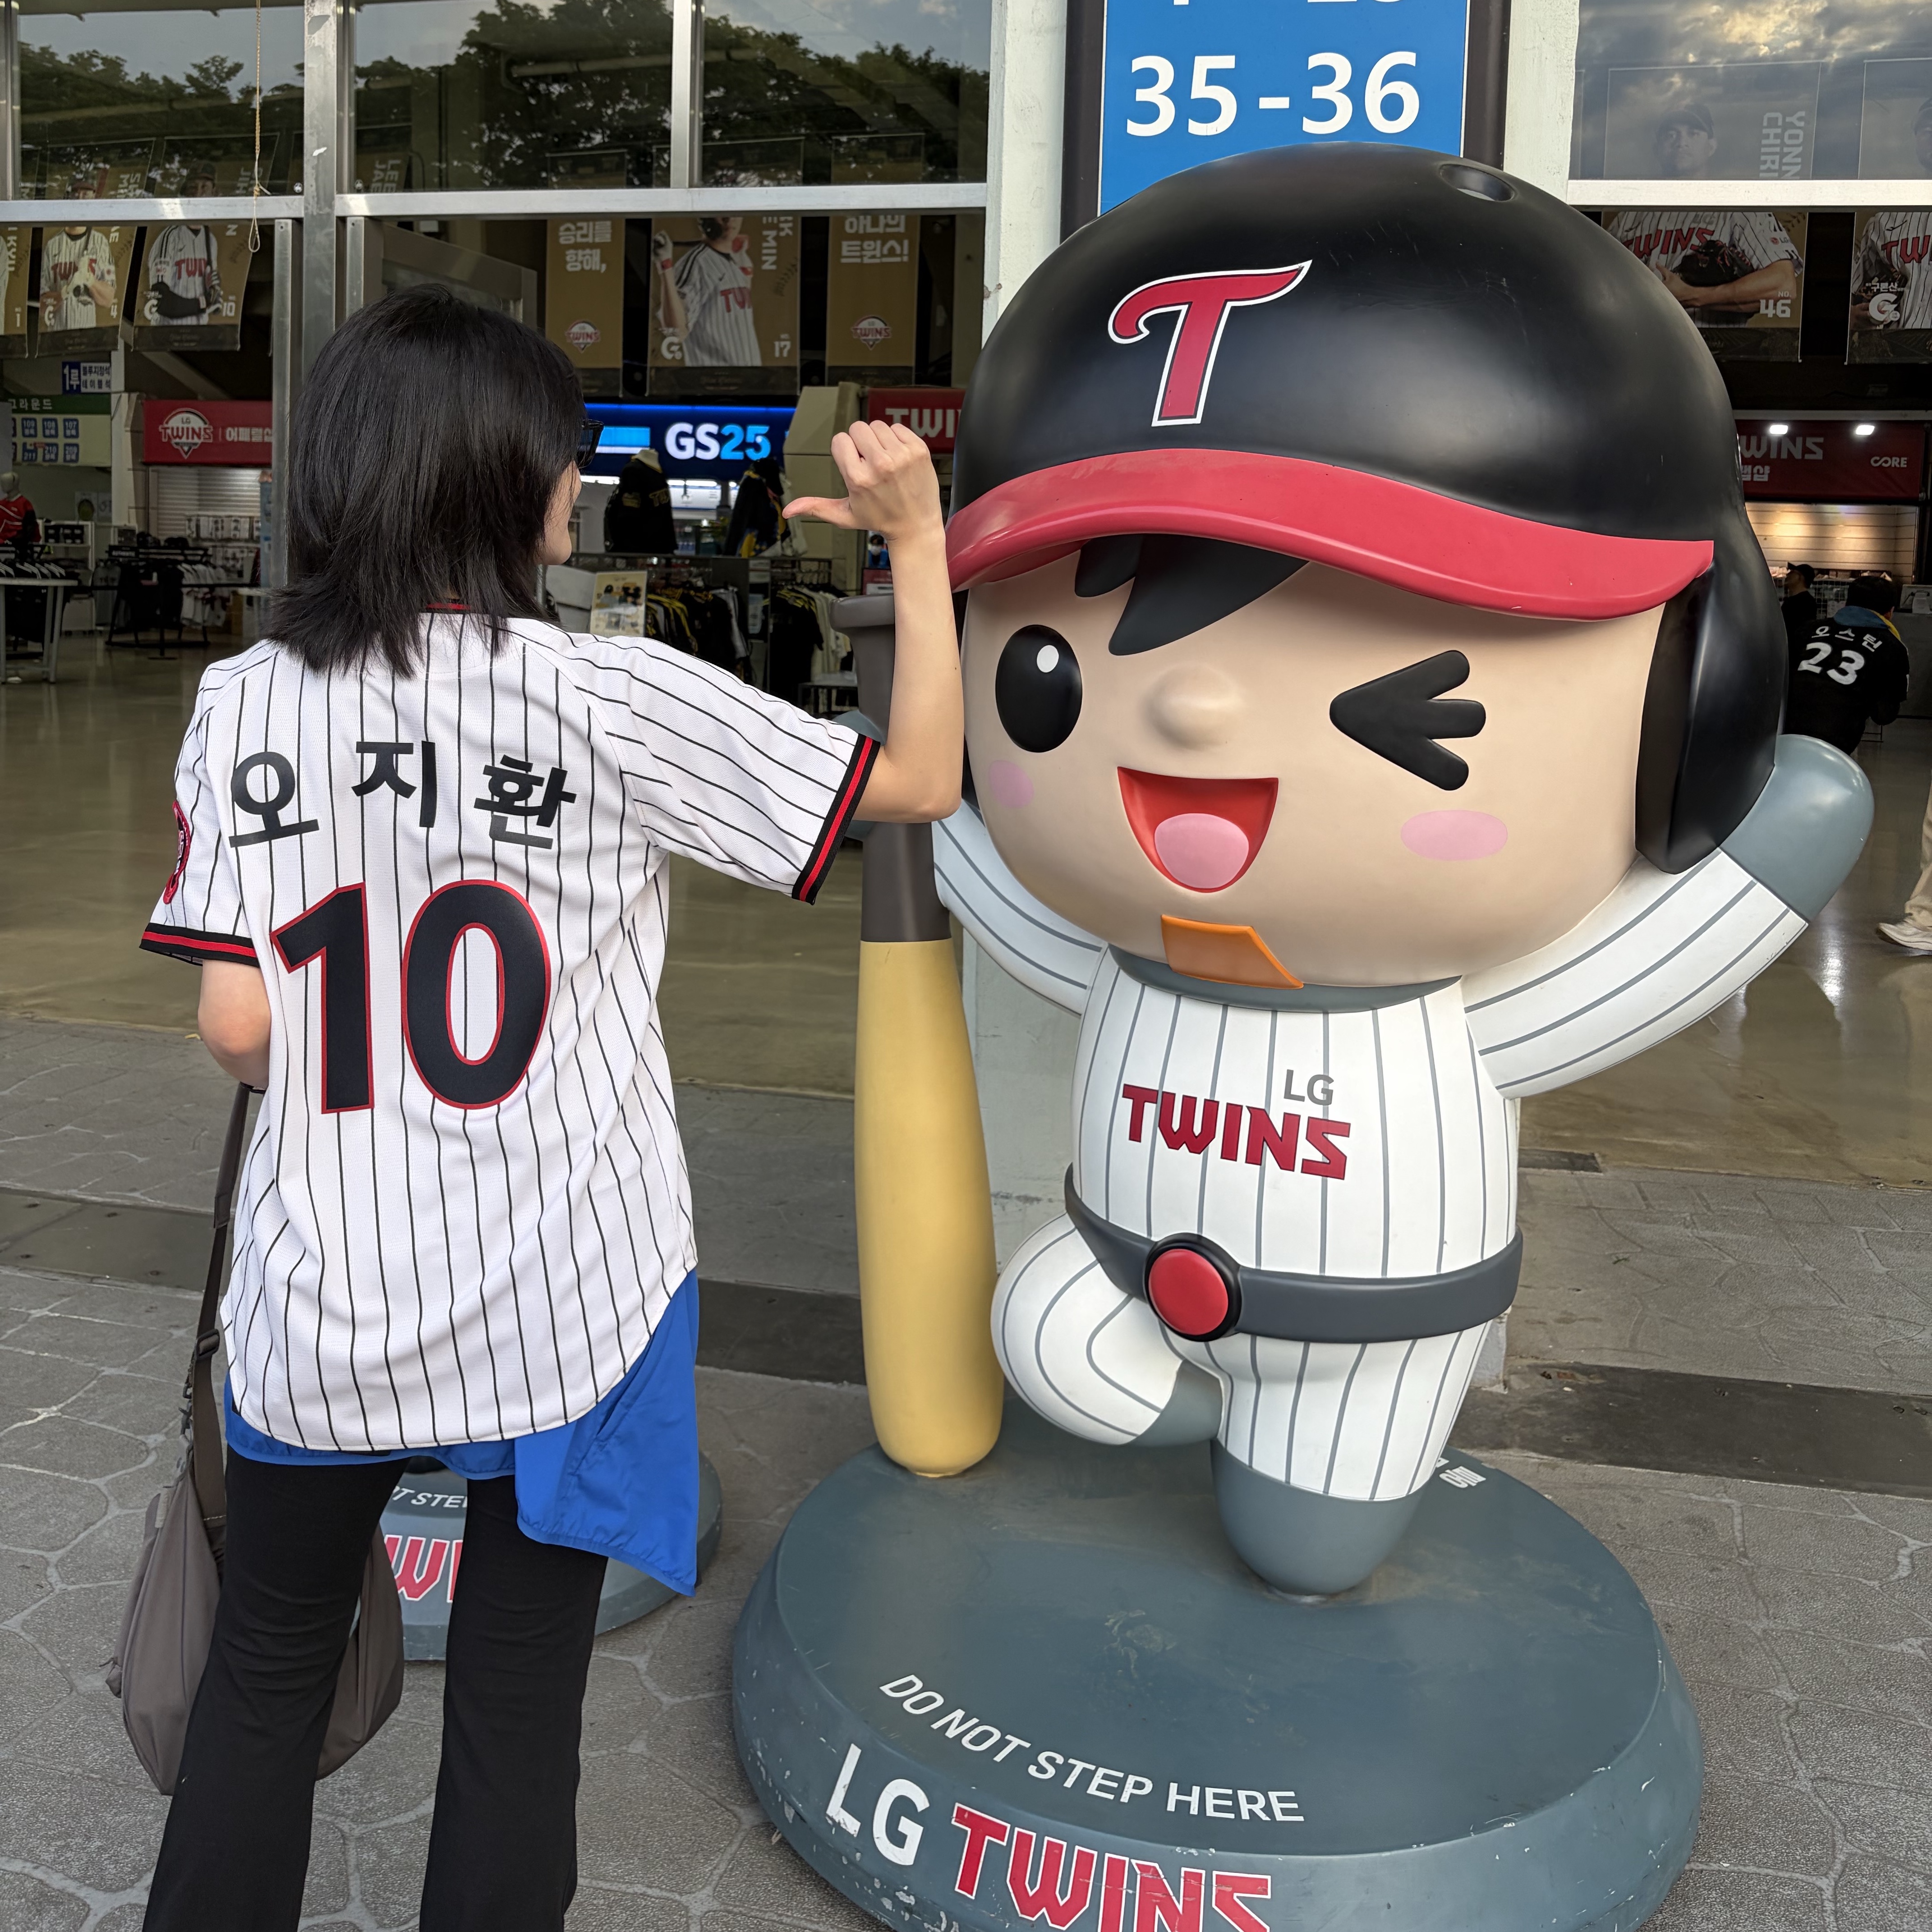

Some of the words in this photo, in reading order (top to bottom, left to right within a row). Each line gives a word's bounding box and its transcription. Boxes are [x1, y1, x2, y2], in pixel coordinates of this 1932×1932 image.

[1126, 51, 1420, 137] 35-36
[558, 220, 612, 244] 승리를
[566, 248, 607, 274] 향해,
[840, 239, 909, 263] 트윈스!
[222, 301, 235, 317] 10
[1759, 299, 1791, 318] 46
[851, 327, 892, 338] TWINS
[774, 341, 791, 358] 17
[63, 364, 80, 390] 1루
[159, 425, 213, 442] TWINS
[665, 422, 771, 461] GS25
[1870, 456, 1908, 468] CORE
[1811, 625, 1883, 652] 오스틴
[1797, 642, 1866, 685] 23
[228, 740, 577, 849] 오지환
[270, 879, 552, 1115] 10
[1283, 1069, 1334, 1106] LG
[1122, 1083, 1352, 1181] TWINS
[392, 1485, 415, 1501] T
[879, 1675, 945, 1715] DO
[930, 1708, 1031, 1762] NOT
[1027, 1751, 1153, 1803] STEP
[1166, 1782, 1305, 1822] HERE
[825, 1743, 930, 1866] LG
[951, 1802, 1271, 1932] TWINS
